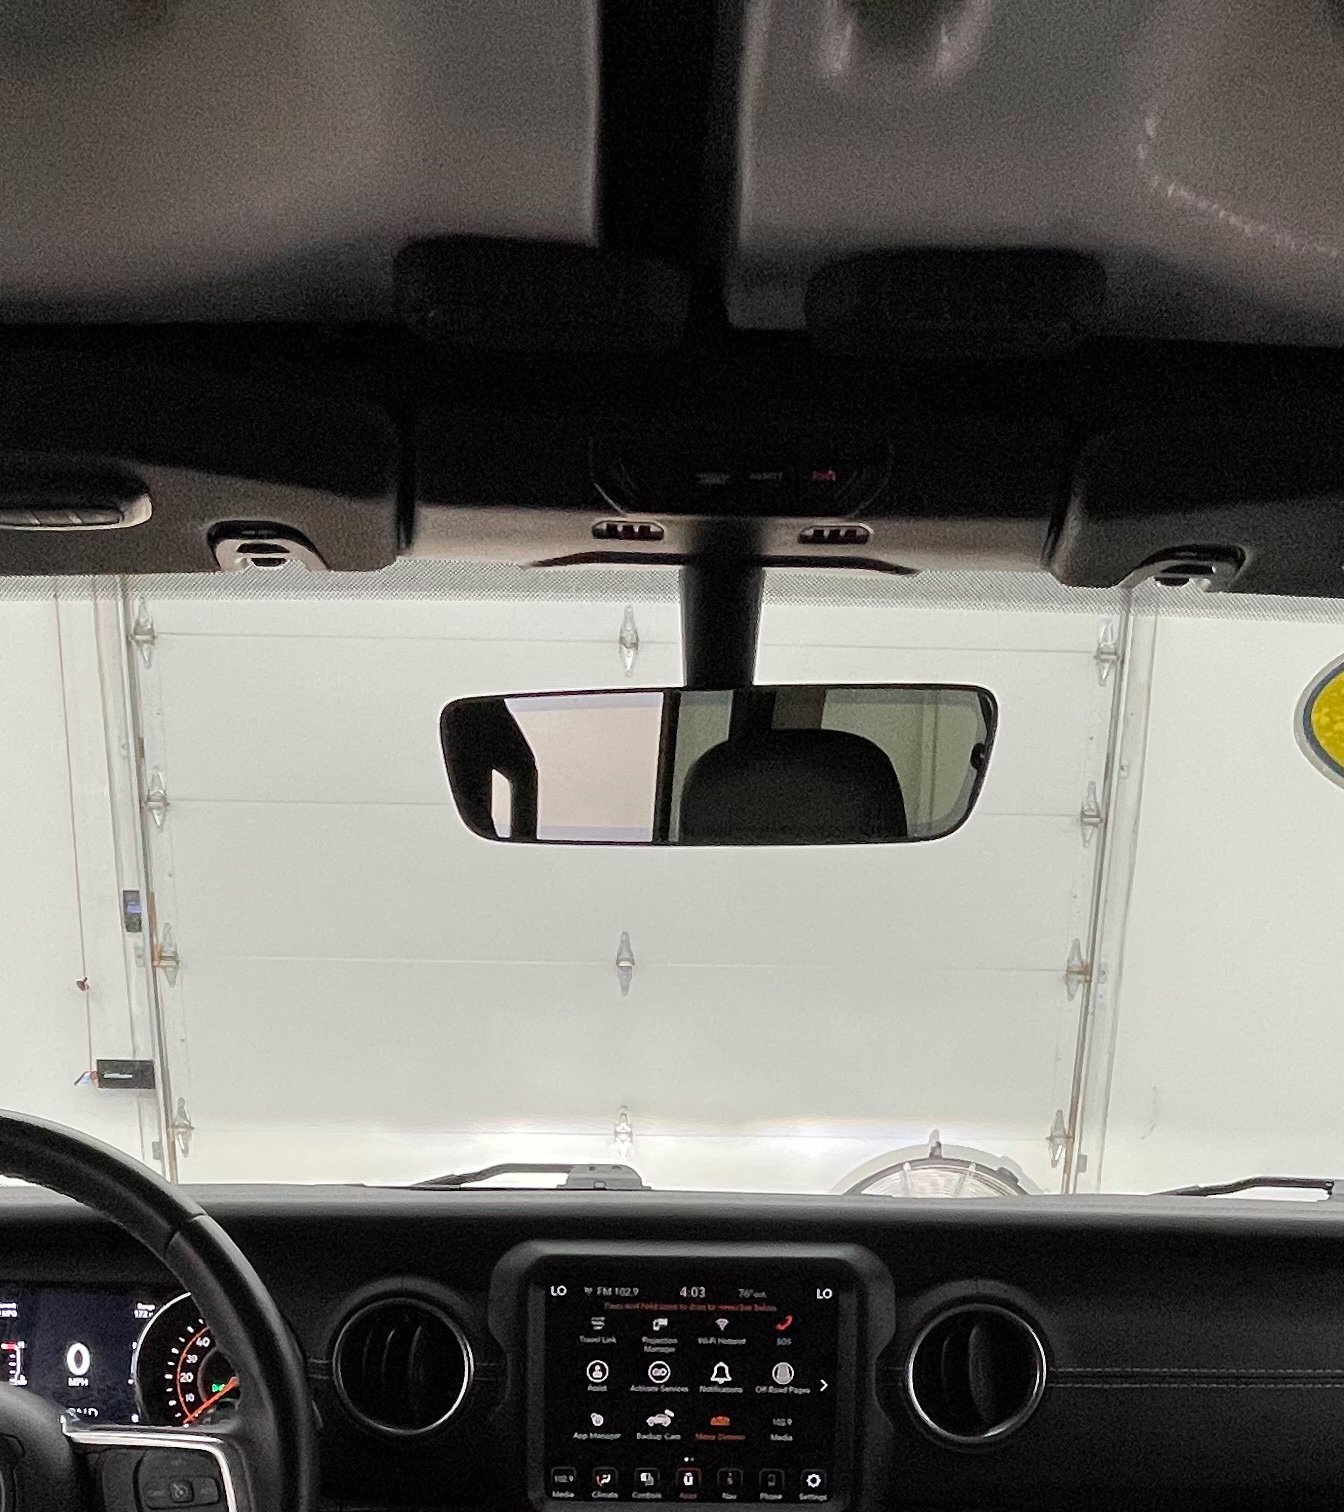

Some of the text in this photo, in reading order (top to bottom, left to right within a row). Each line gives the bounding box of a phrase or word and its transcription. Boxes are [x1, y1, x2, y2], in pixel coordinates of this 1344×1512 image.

[550, 1285, 567, 1296] LO
[596, 1287, 639, 1297] FM 102.9
[679, 1286, 706, 1298] 4:03
[816, 1288, 833, 1299] LO
[196, 1336, 211, 1348] 40
[66, 1342, 91, 1376] 0
[186, 1354, 198, 1364] 30
[179, 1372, 194, 1383] 20
[185, 1393, 195, 1402] 10
